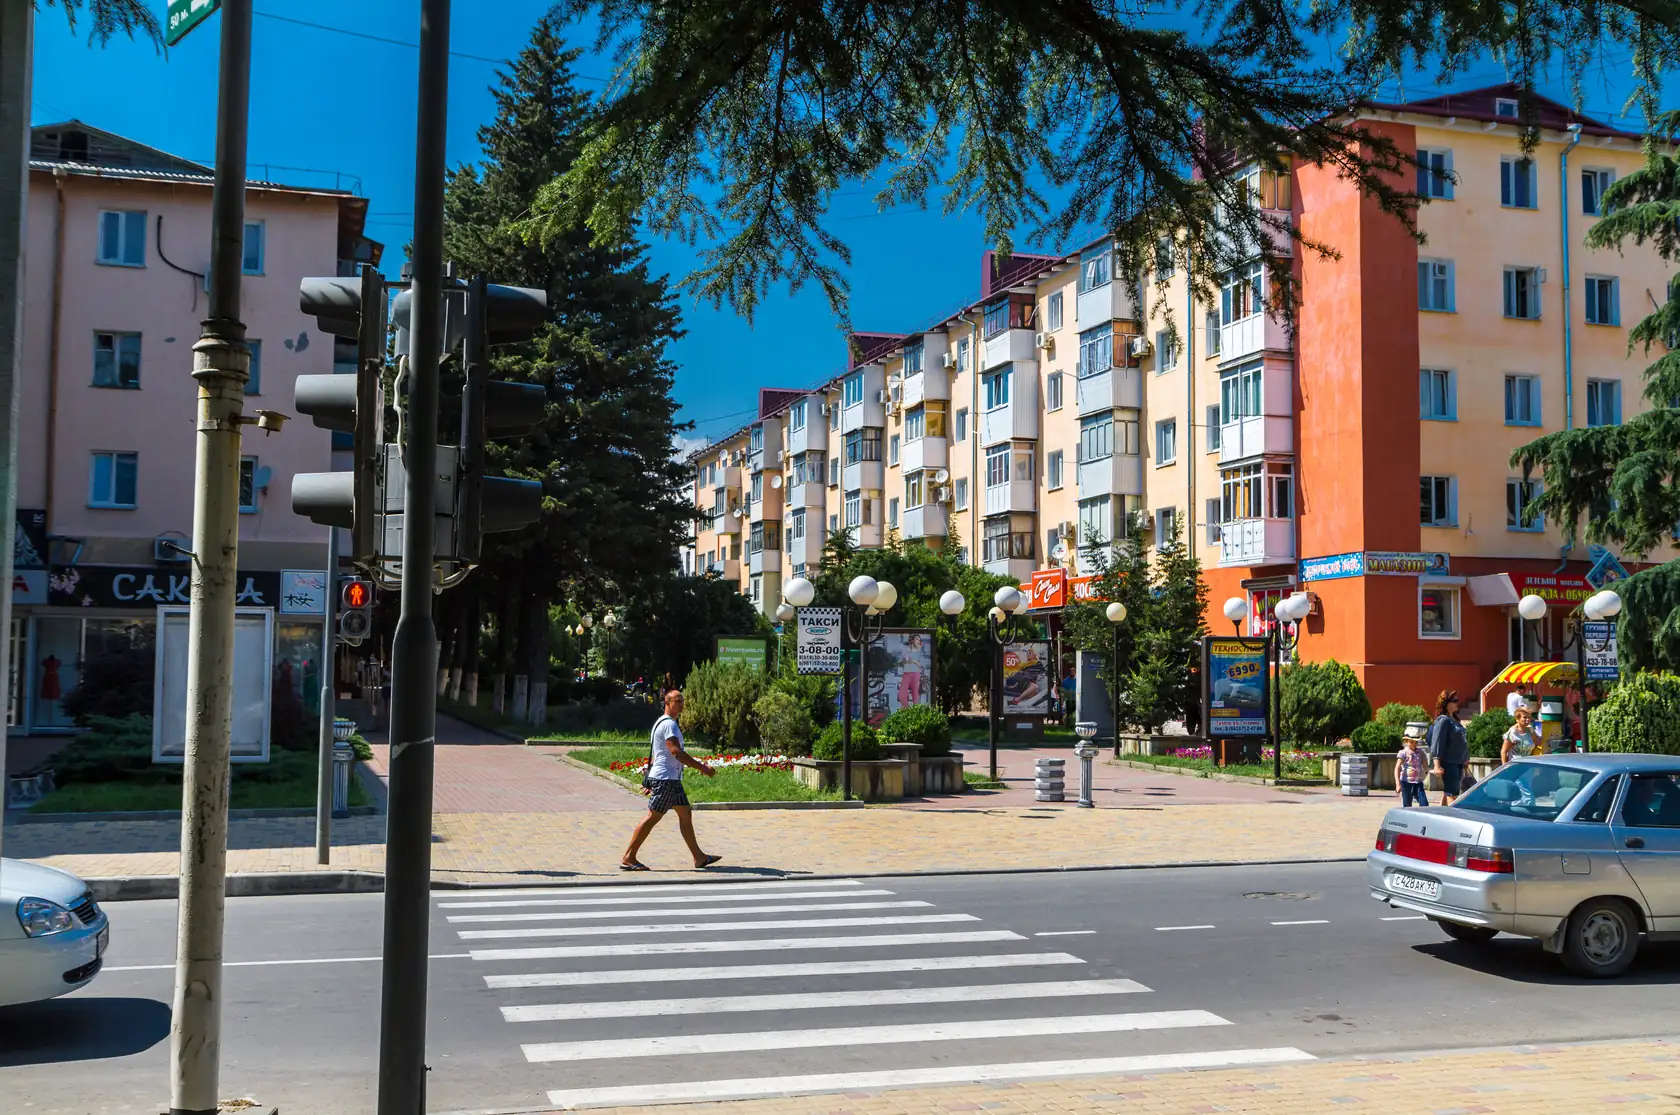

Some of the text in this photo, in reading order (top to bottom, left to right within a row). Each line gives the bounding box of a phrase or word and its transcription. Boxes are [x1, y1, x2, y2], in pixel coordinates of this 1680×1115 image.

[170, 12, 179, 30] 50
[1368, 558, 1426, 573] МАГАЗИН
[1526, 576, 1557, 585] ДЕТСКИЙ
[113, 573, 265, 604] САКА
[800, 617, 839, 626] ТАКСИ
[799, 646, 839, 654] 3-08-00
[1395, 875, 1425, 891] С428АК
